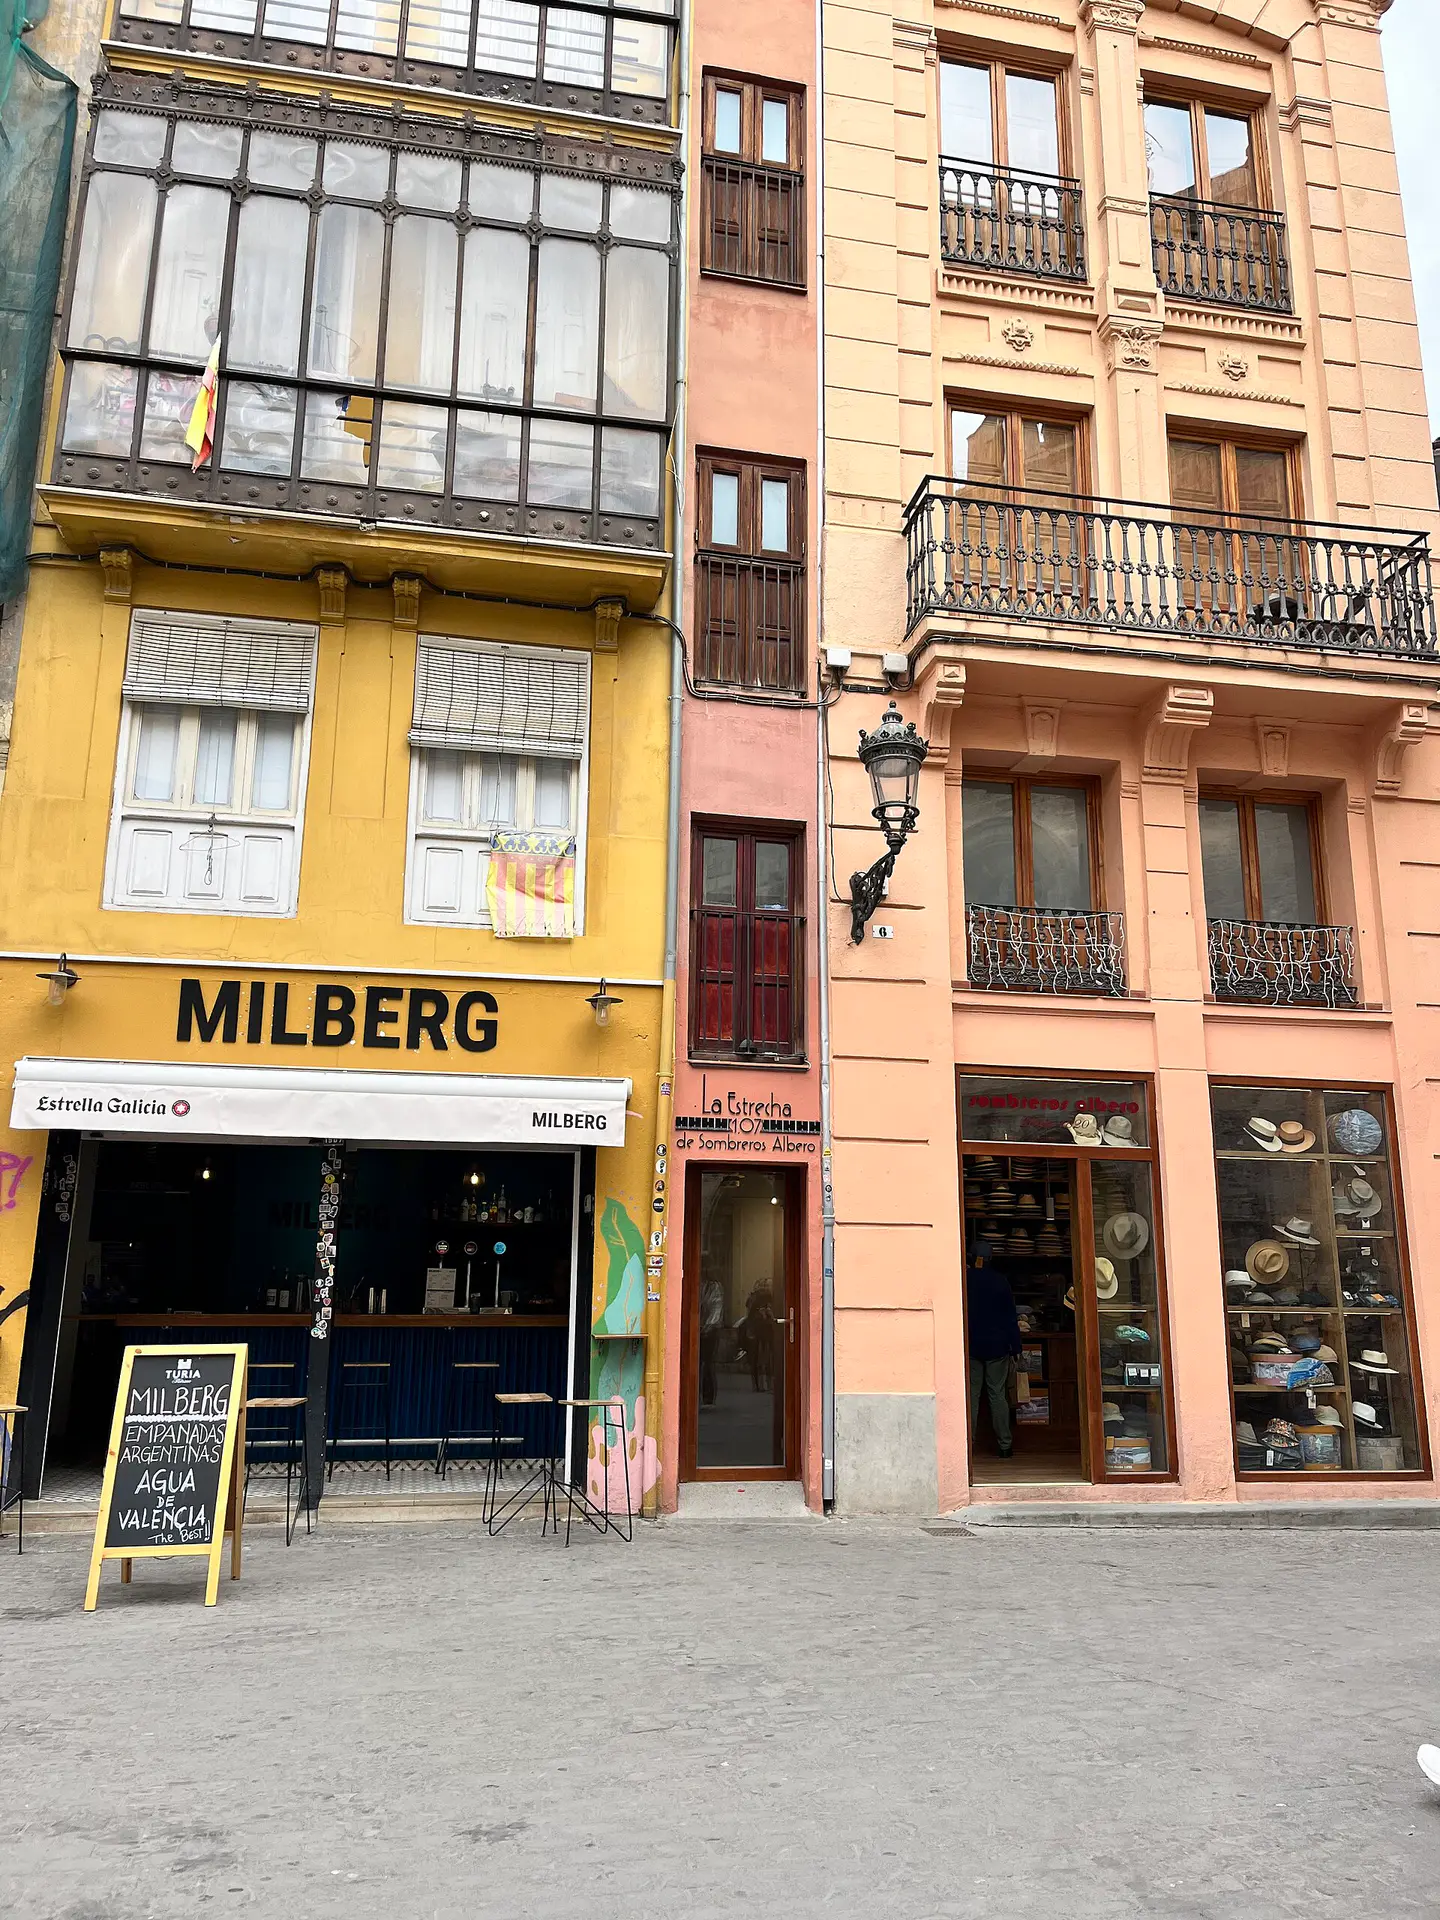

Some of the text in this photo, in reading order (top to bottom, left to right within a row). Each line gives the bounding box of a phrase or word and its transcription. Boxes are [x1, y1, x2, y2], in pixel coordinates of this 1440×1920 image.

[879, 927, 887, 937] 6
[176, 979, 499, 1052] MILBERG
[36, 1096, 103, 1112] Estrella
[107, 1097, 167, 1115] Galicia
[702, 1073, 722, 1115] La
[727, 1092, 792, 1118] Estrecha
[968, 1093, 1140, 1114] sombreros albero
[531, 1111, 608, 1131] MILBERG
[676, 1132, 816, 1152] de Sombreros Albero
[165, 1370, 201, 1379] TURIA
[130, 1384, 230, 1415] MILBERG
[125, 1423, 226, 1445] EMPANADAS
[119, 1444, 221, 1465] ARGENTINAS
[134, 1468, 196, 1495] AGUA
[156, 1495, 175, 1508] DE
[148, 1532, 174, 1544] The
